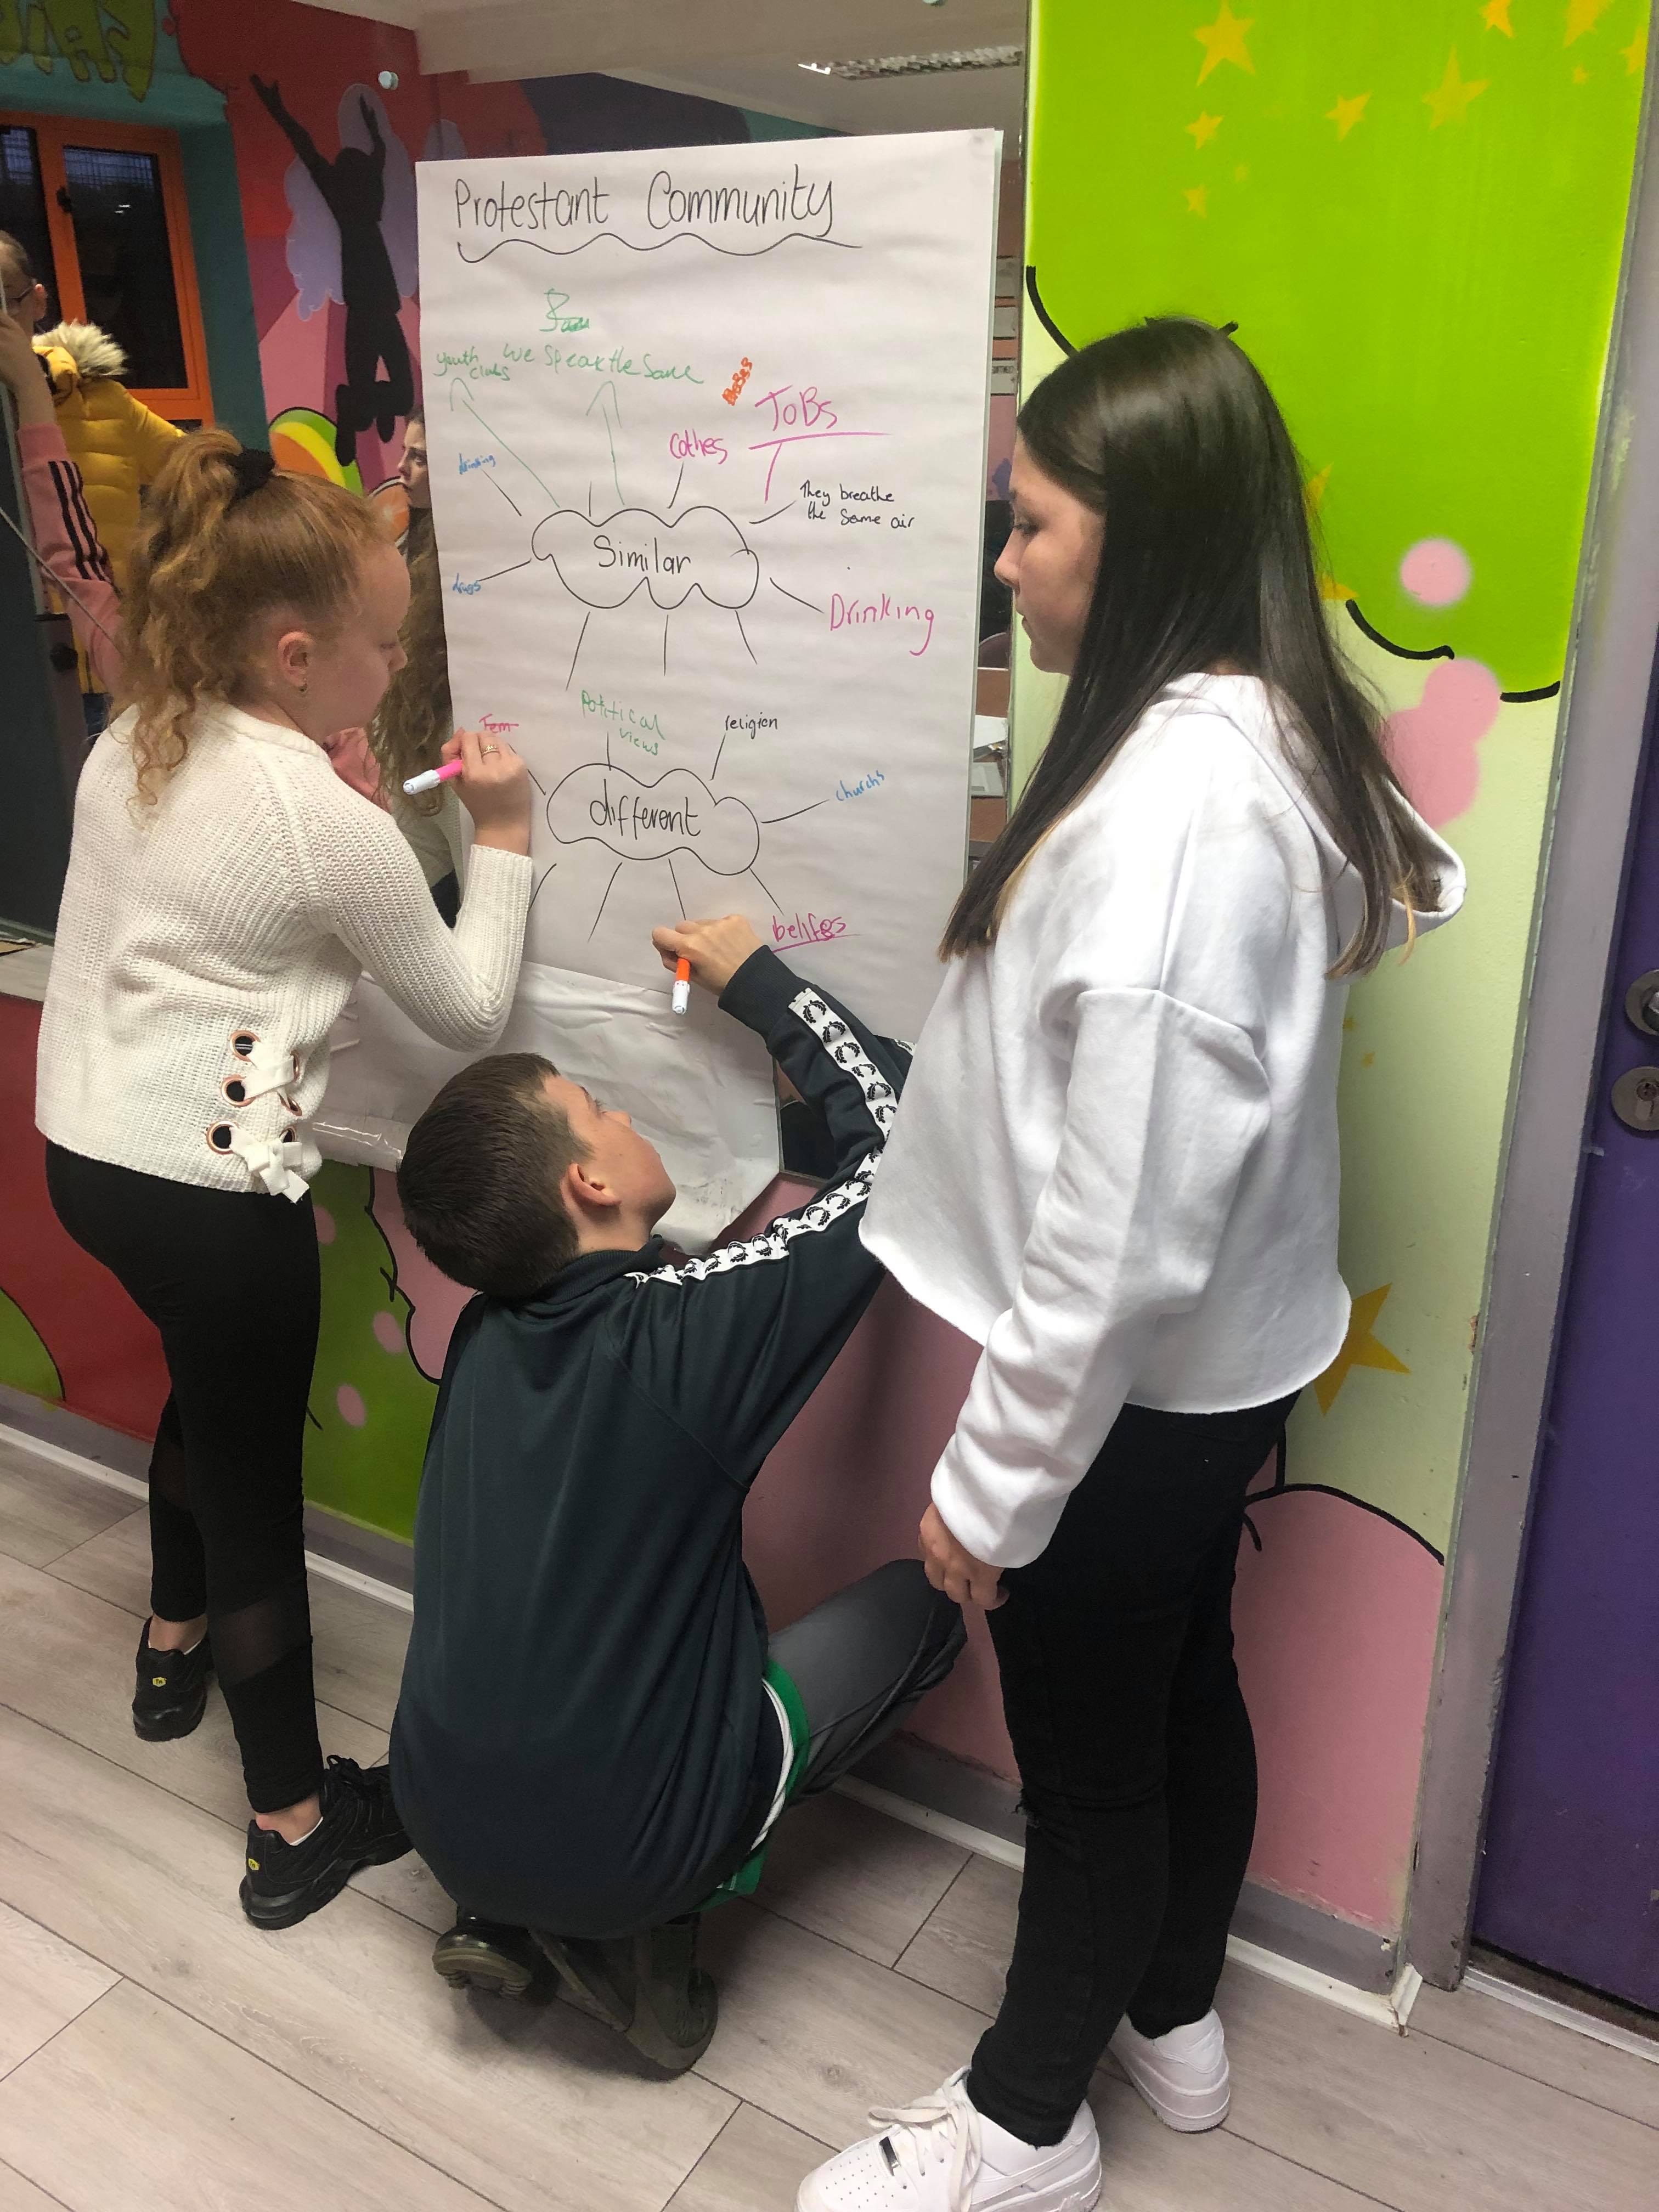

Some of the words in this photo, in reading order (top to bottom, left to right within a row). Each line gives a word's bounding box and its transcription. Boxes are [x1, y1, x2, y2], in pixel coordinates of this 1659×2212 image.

[455, 177, 610, 229] Protestant
[647, 163, 833, 239] Community
[800, 479, 830, 507] They
[839, 483, 894, 503] breathe
[808, 500, 826, 520] the
[890, 514, 915, 529] air
[593, 534, 691, 575] Similar
[830, 592, 934, 656] Drinking
[725, 712, 778, 740] religion
[590, 779, 701, 839] different
